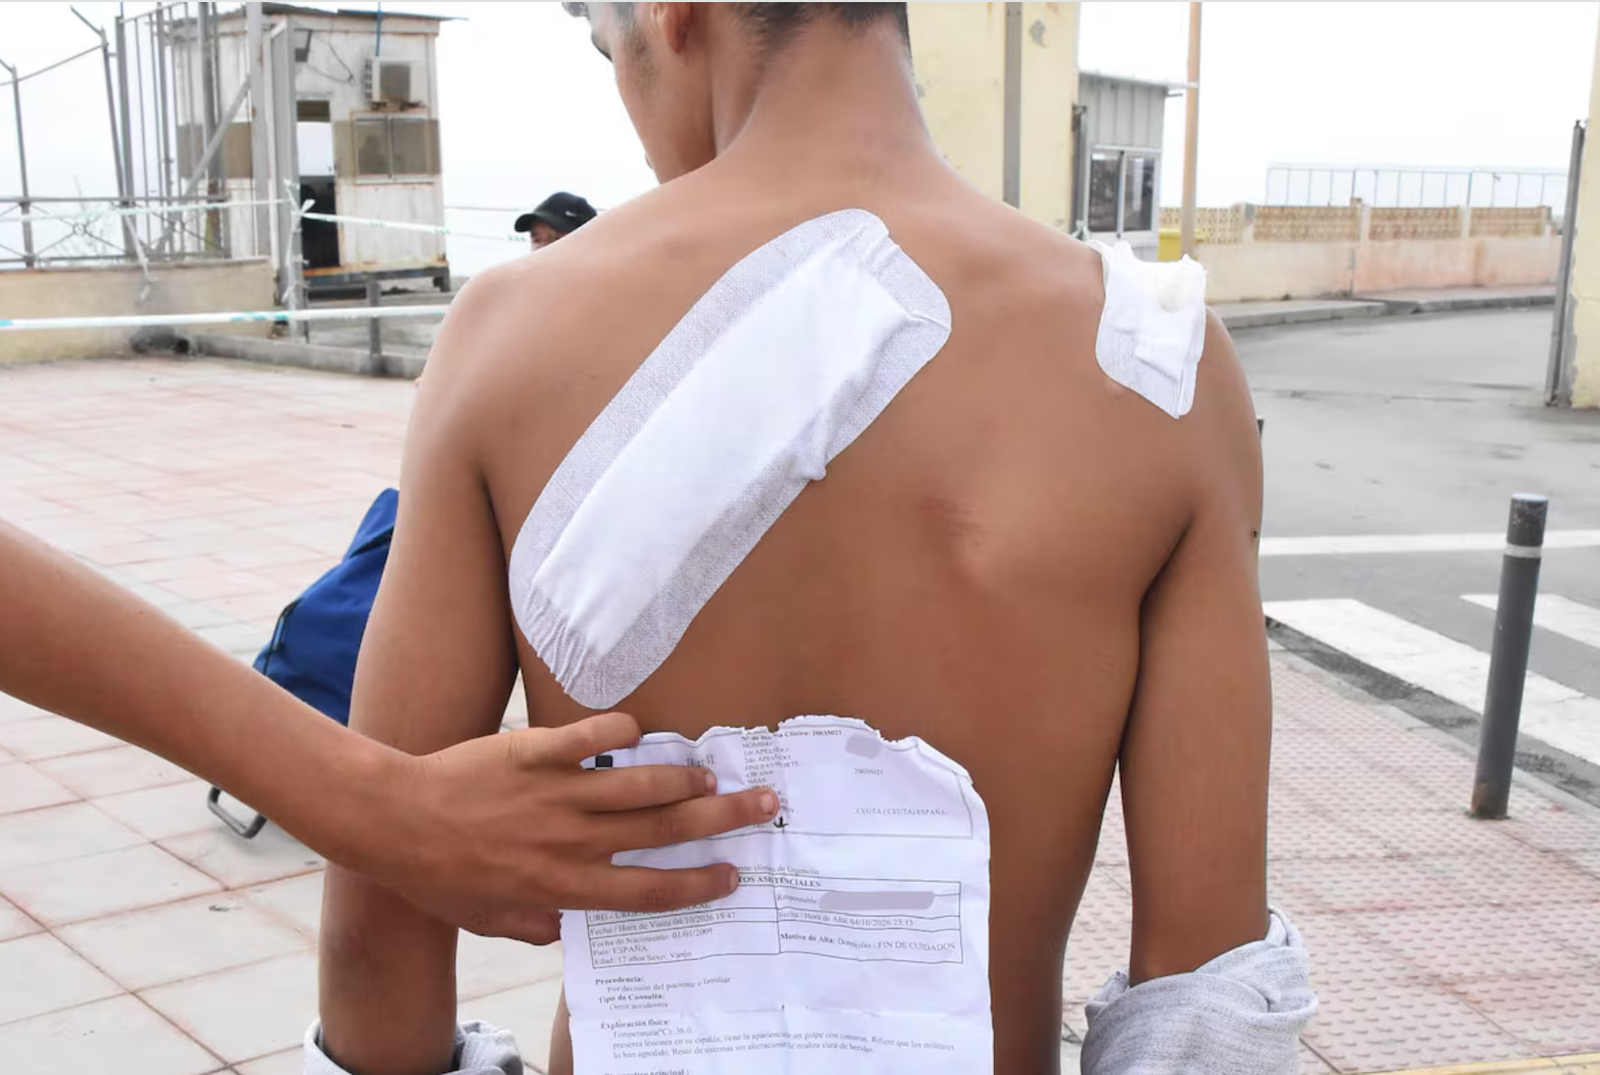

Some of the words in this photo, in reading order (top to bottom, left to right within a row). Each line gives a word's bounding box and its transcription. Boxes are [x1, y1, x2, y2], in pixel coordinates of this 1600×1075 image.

[787, 866, 820, 876] Urgencias
[588, 914, 608, 922] URG
[779, 911, 799, 919] Fecha
[804, 912, 821, 921] Hora
[590, 926, 611, 936] Fecha
[618, 924, 637, 933] Hora
[639, 922, 648, 930] de
[672, 914, 714, 926] 04/10/2026
[592, 940, 614, 949] Fecha
[616, 938, 625, 946] de
[626, 934, 671, 945] Nacimiento:
[780, 932, 807, 941] Motivo
[808, 934, 817, 942] de
[818, 936, 836, 945] Alta:
[838, 938, 872, 949] Domicilio
[878, 941, 893, 949] FIN
[895, 941, 908, 949] DE
[908, 942, 956, 951] CUIDADOS
[612, 944, 648, 954] ESPAÑA
[630, 954, 645, 962] años
[647, 953, 666, 962] Sexo:
[596, 976, 645, 986] Procedencia:
[666, 981, 696, 992] paciente
[704, 976, 731, 986] familiar
[598, 996, 616, 1004] Tipo
[631, 1002, 669, 1010] accidentes
[601, 1019, 647, 1030] Exploración
[644, 1038, 673, 1047] lesiones
[674, 1038, 684, 1046] en
[724, 1034, 741, 1042] tiene
[743, 1032, 751, 1041] la
[872, 1036, 895, 1046] Refiere
[897, 1040, 910, 1049] que
[911, 1040, 922, 1049] los
[622, 1050, 636, 1059] han
[694, 1047, 703, 1055] de
[704, 1045, 733, 1054] sistemas
[735, 1043, 746, 1051] sin
[797, 1042, 821, 1050] realiza
[822, 1042, 838, 1050] cura
[840, 1042, 848, 1050] de
